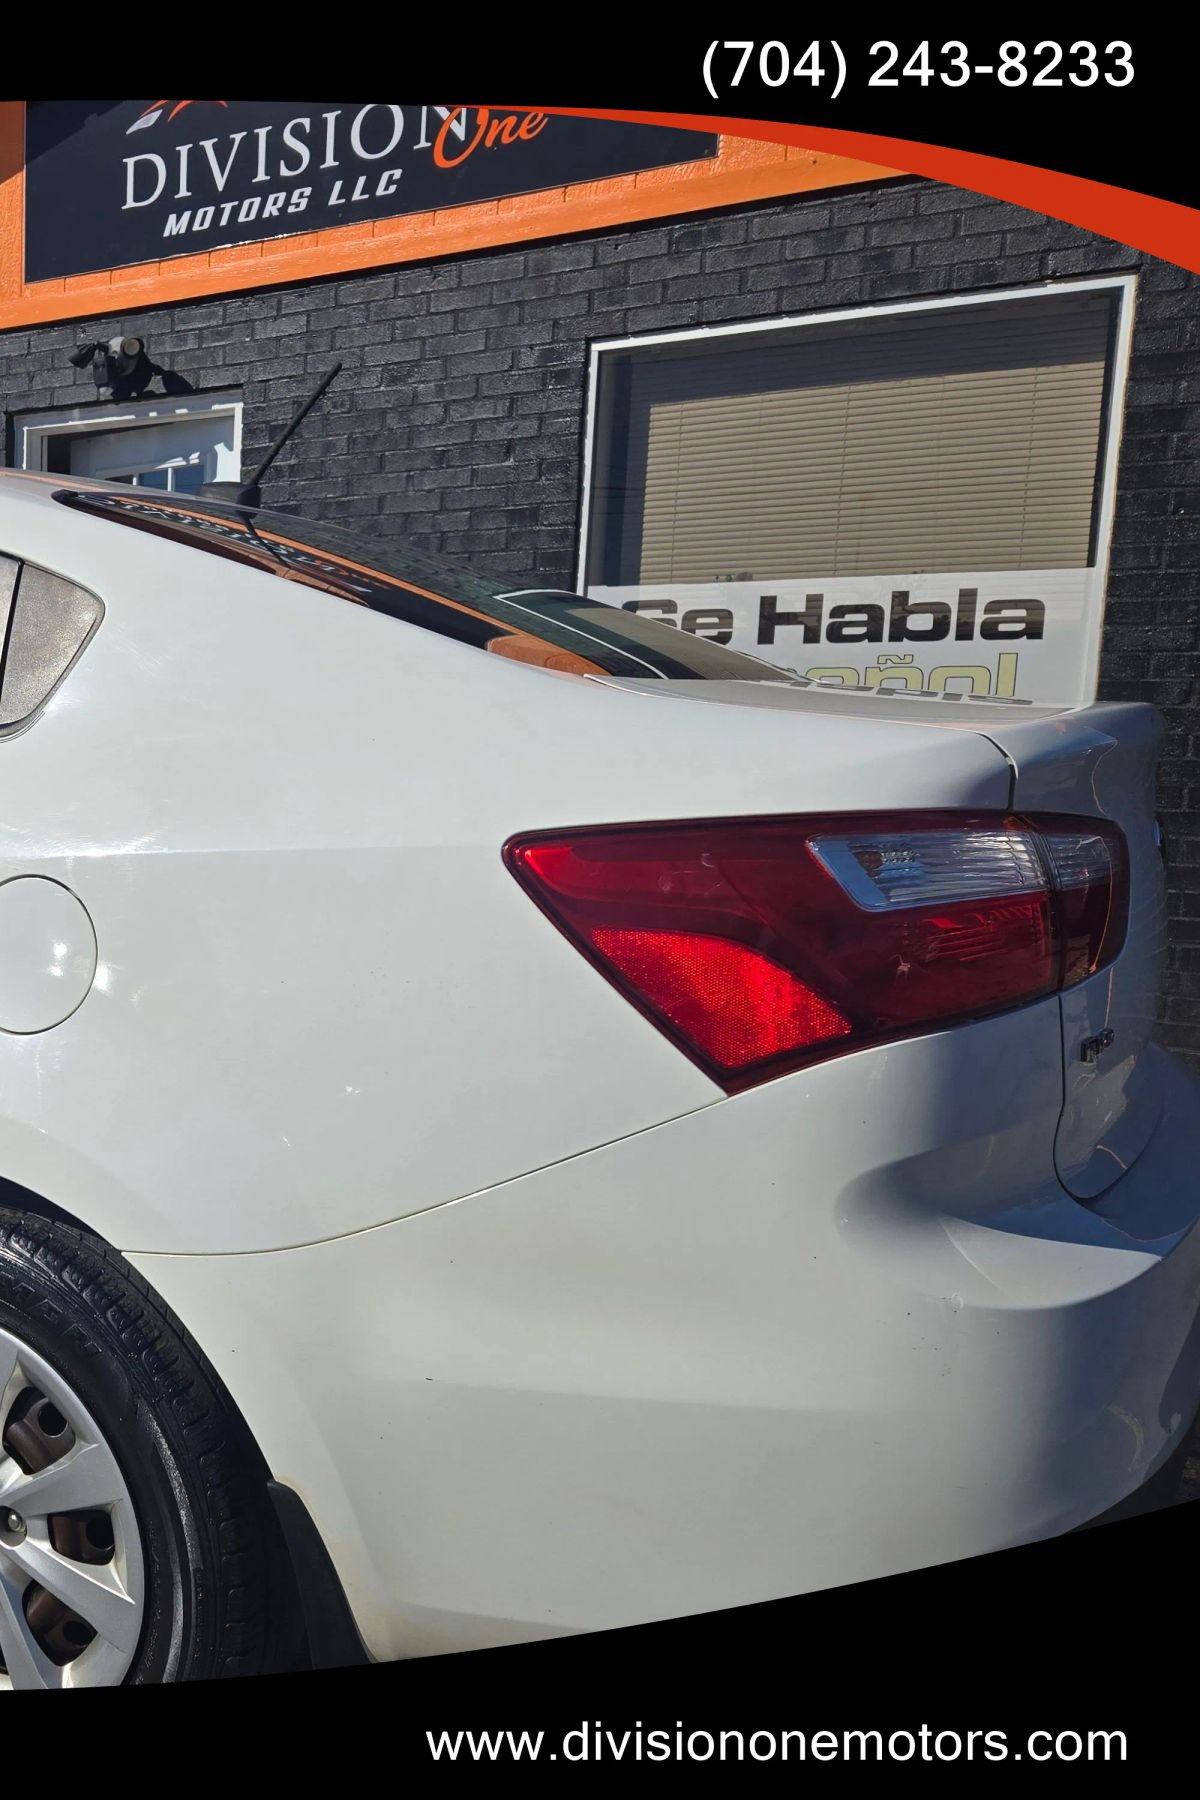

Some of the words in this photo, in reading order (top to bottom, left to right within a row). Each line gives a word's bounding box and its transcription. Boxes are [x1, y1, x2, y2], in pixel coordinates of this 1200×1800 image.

[120, 103, 467, 210] DIVISION
[433, 107, 549, 169] One
[162, 187, 312, 237] MOTORS
[327, 168, 403, 206] LLC
[756, 588, 1046, 645] Habla
